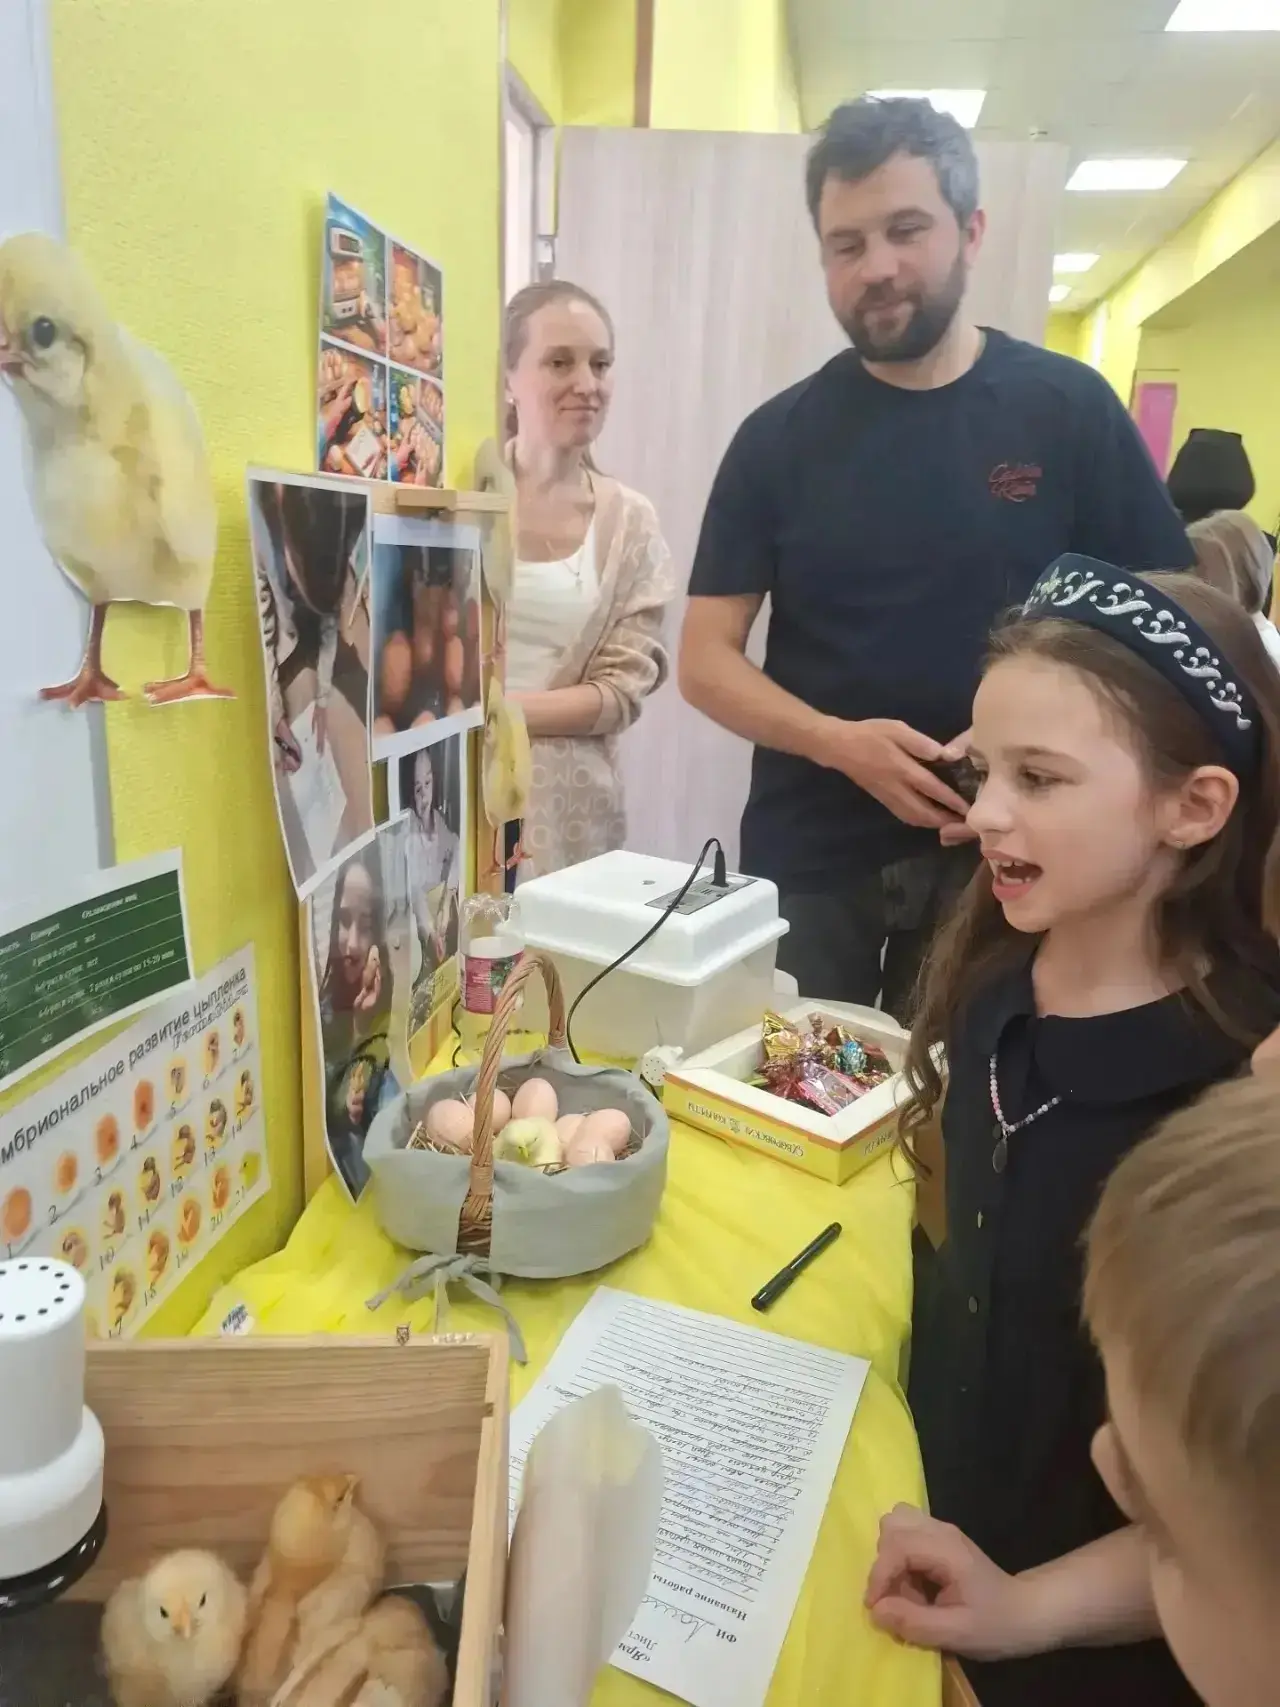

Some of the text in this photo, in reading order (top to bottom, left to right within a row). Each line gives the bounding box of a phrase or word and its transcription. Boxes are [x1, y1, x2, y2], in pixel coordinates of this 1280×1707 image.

[128, 1010, 189, 1071] развитие
[193, 968, 246, 1018] цыпленка
[232, 1122, 243, 1140] 14
[130, 1135, 139, 1150] 4
[94, 1166, 102, 1186] 3
[49, 1205, 59, 1225] 2
[652, 1572, 747, 1622] Название работы
[715, 1627, 737, 1645] ФИ
